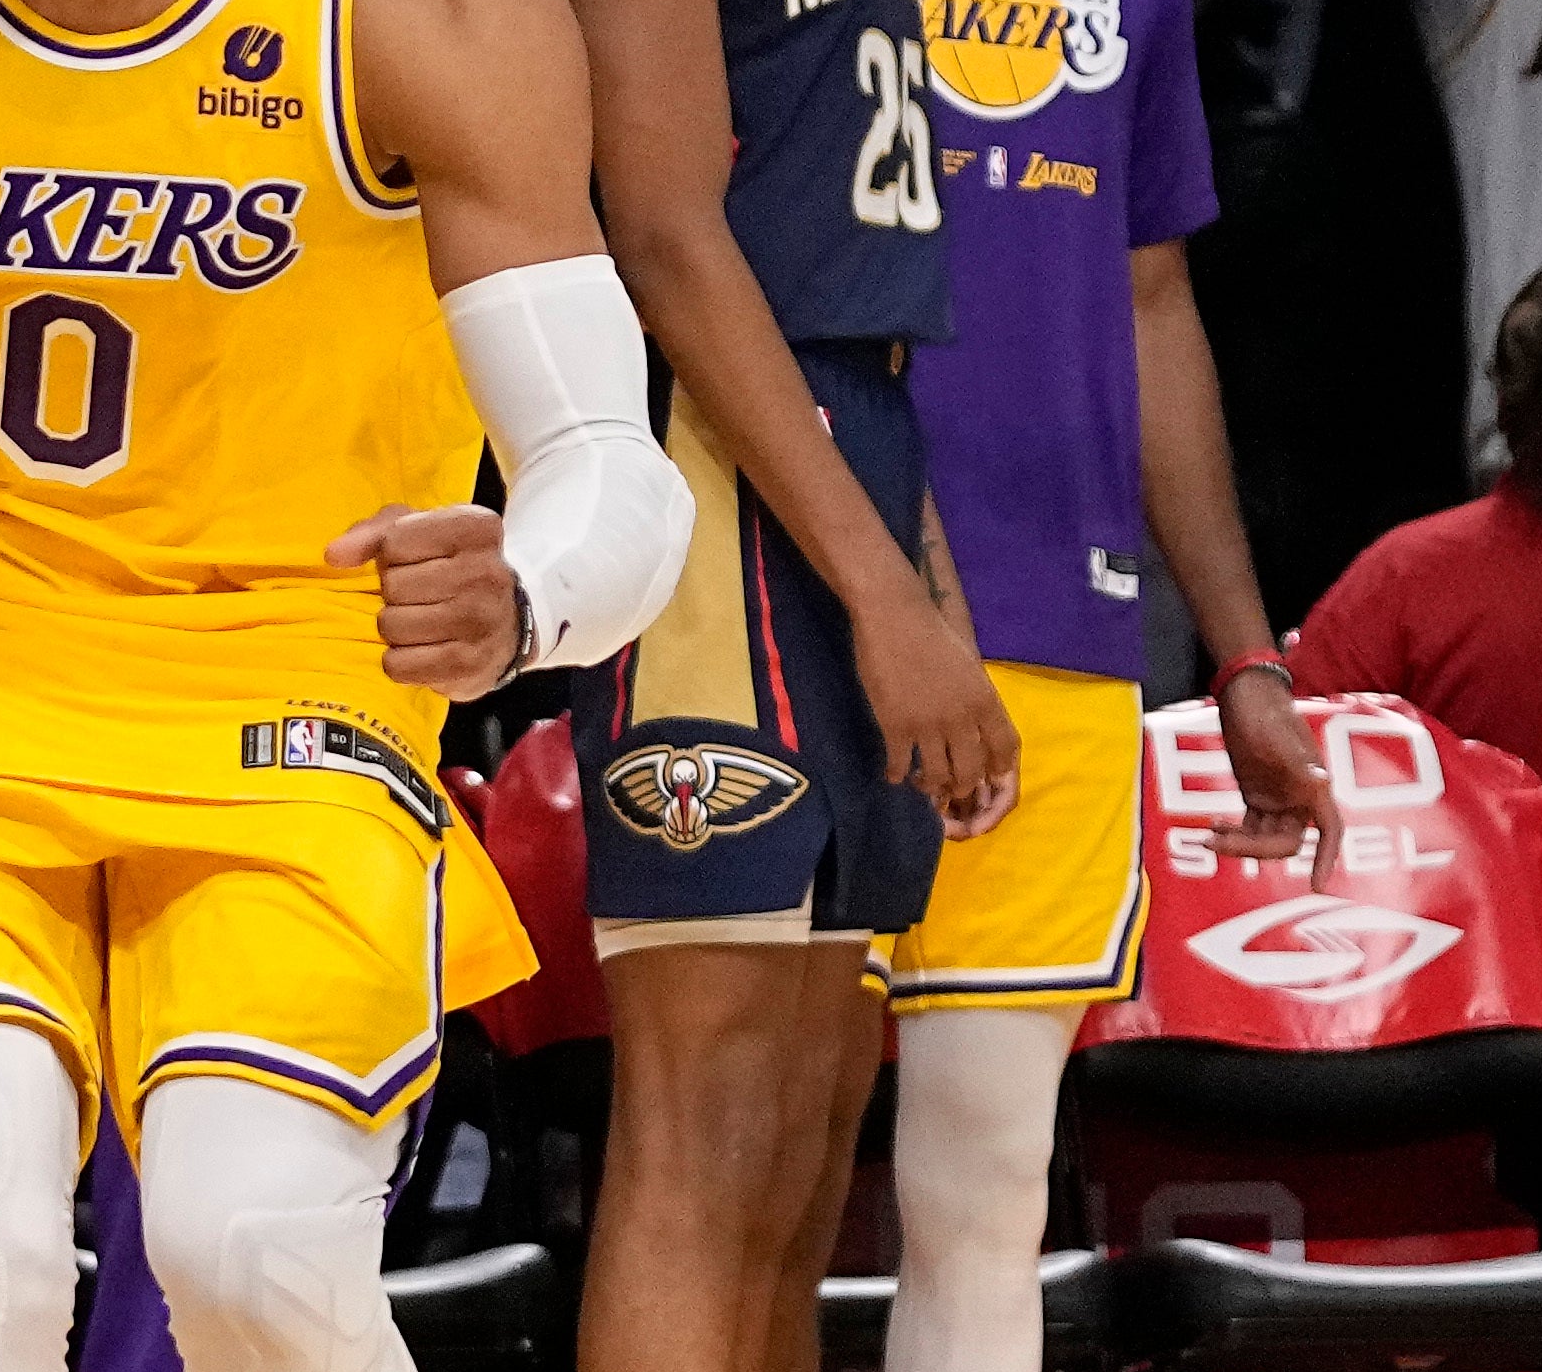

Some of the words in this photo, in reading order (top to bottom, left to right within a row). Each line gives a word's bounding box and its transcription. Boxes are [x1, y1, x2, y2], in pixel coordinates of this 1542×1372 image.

[198, 85, 304, 129] bibigo
[852, 27, 942, 233] 25
[1146, 707, 1445, 811] BO
